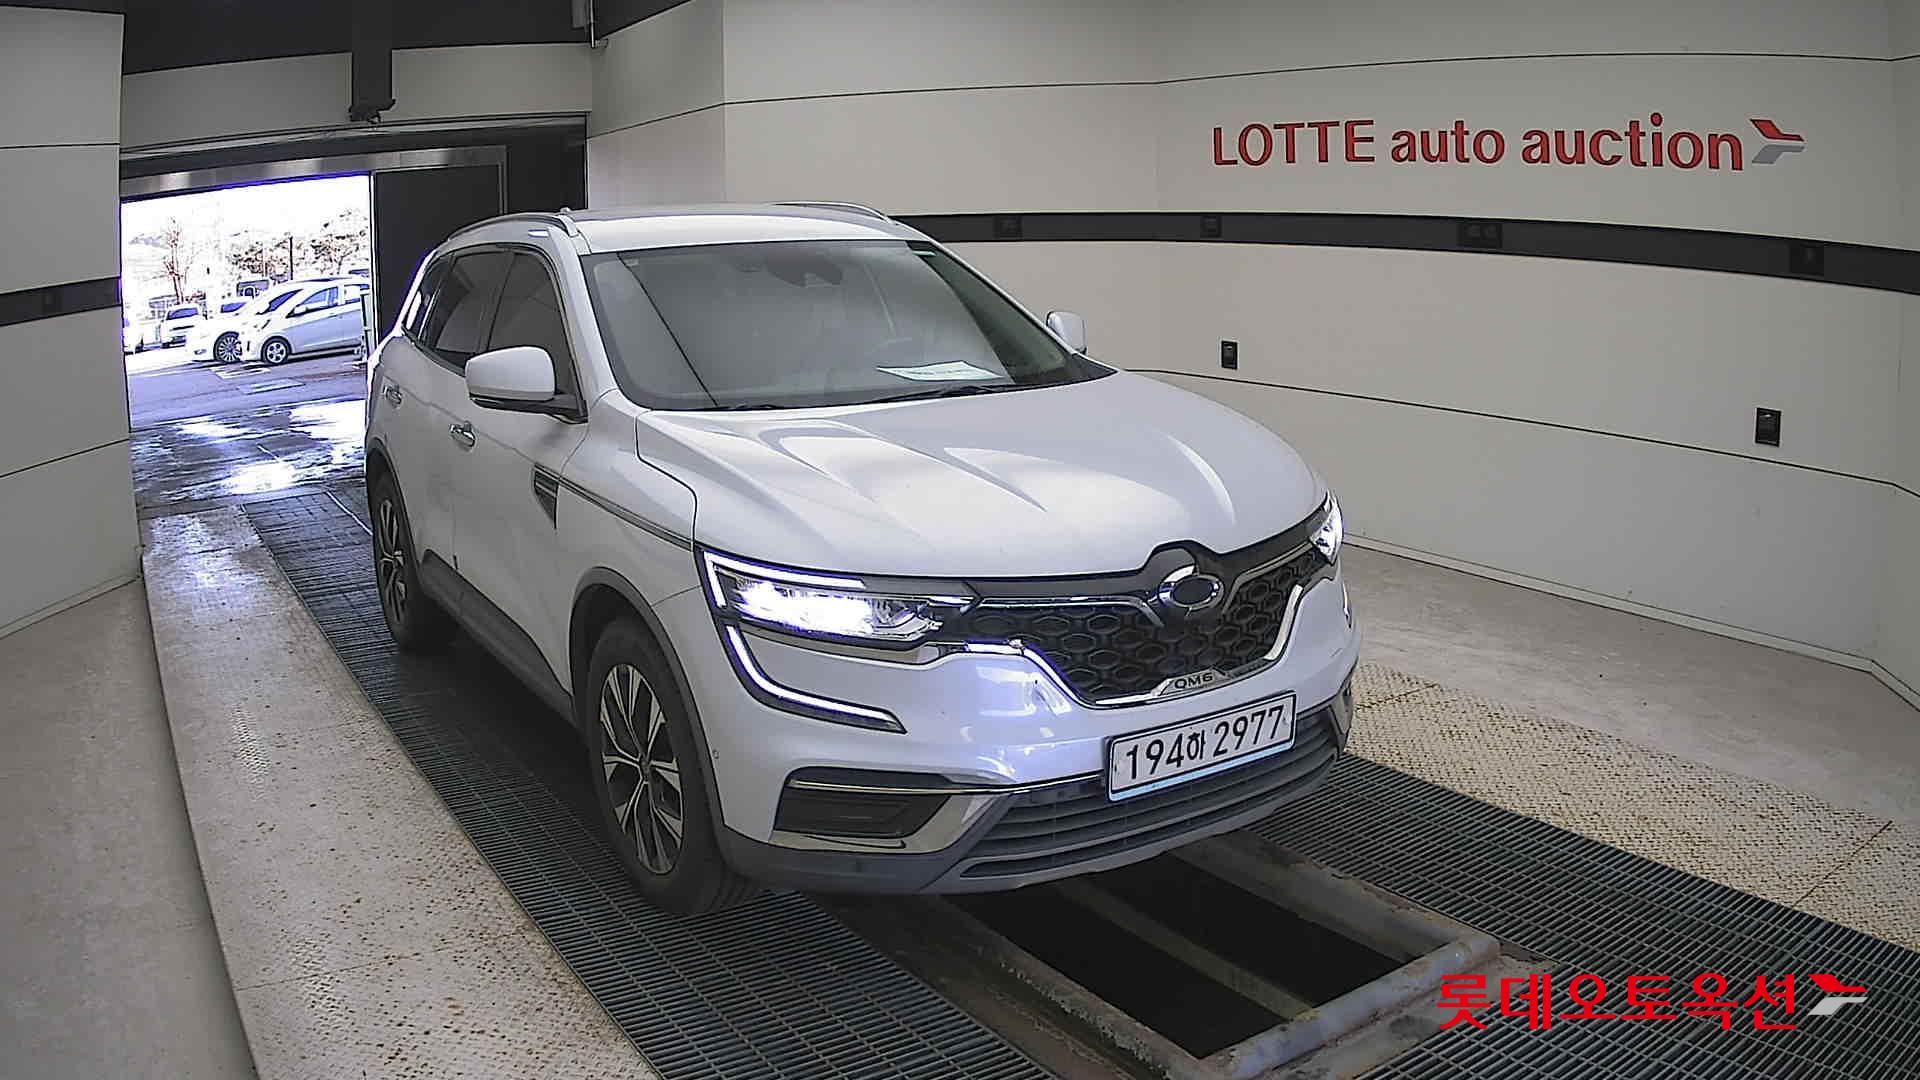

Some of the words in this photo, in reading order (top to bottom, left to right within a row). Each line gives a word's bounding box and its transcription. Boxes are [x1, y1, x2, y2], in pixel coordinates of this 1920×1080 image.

[1213, 120, 1375, 166] LOTTE
[1391, 121, 1504, 164] auto
[1522, 112, 1743, 171] auction
[1174, 672, 1213, 689] QM6
[1213, 704, 1285, 758] 2977
